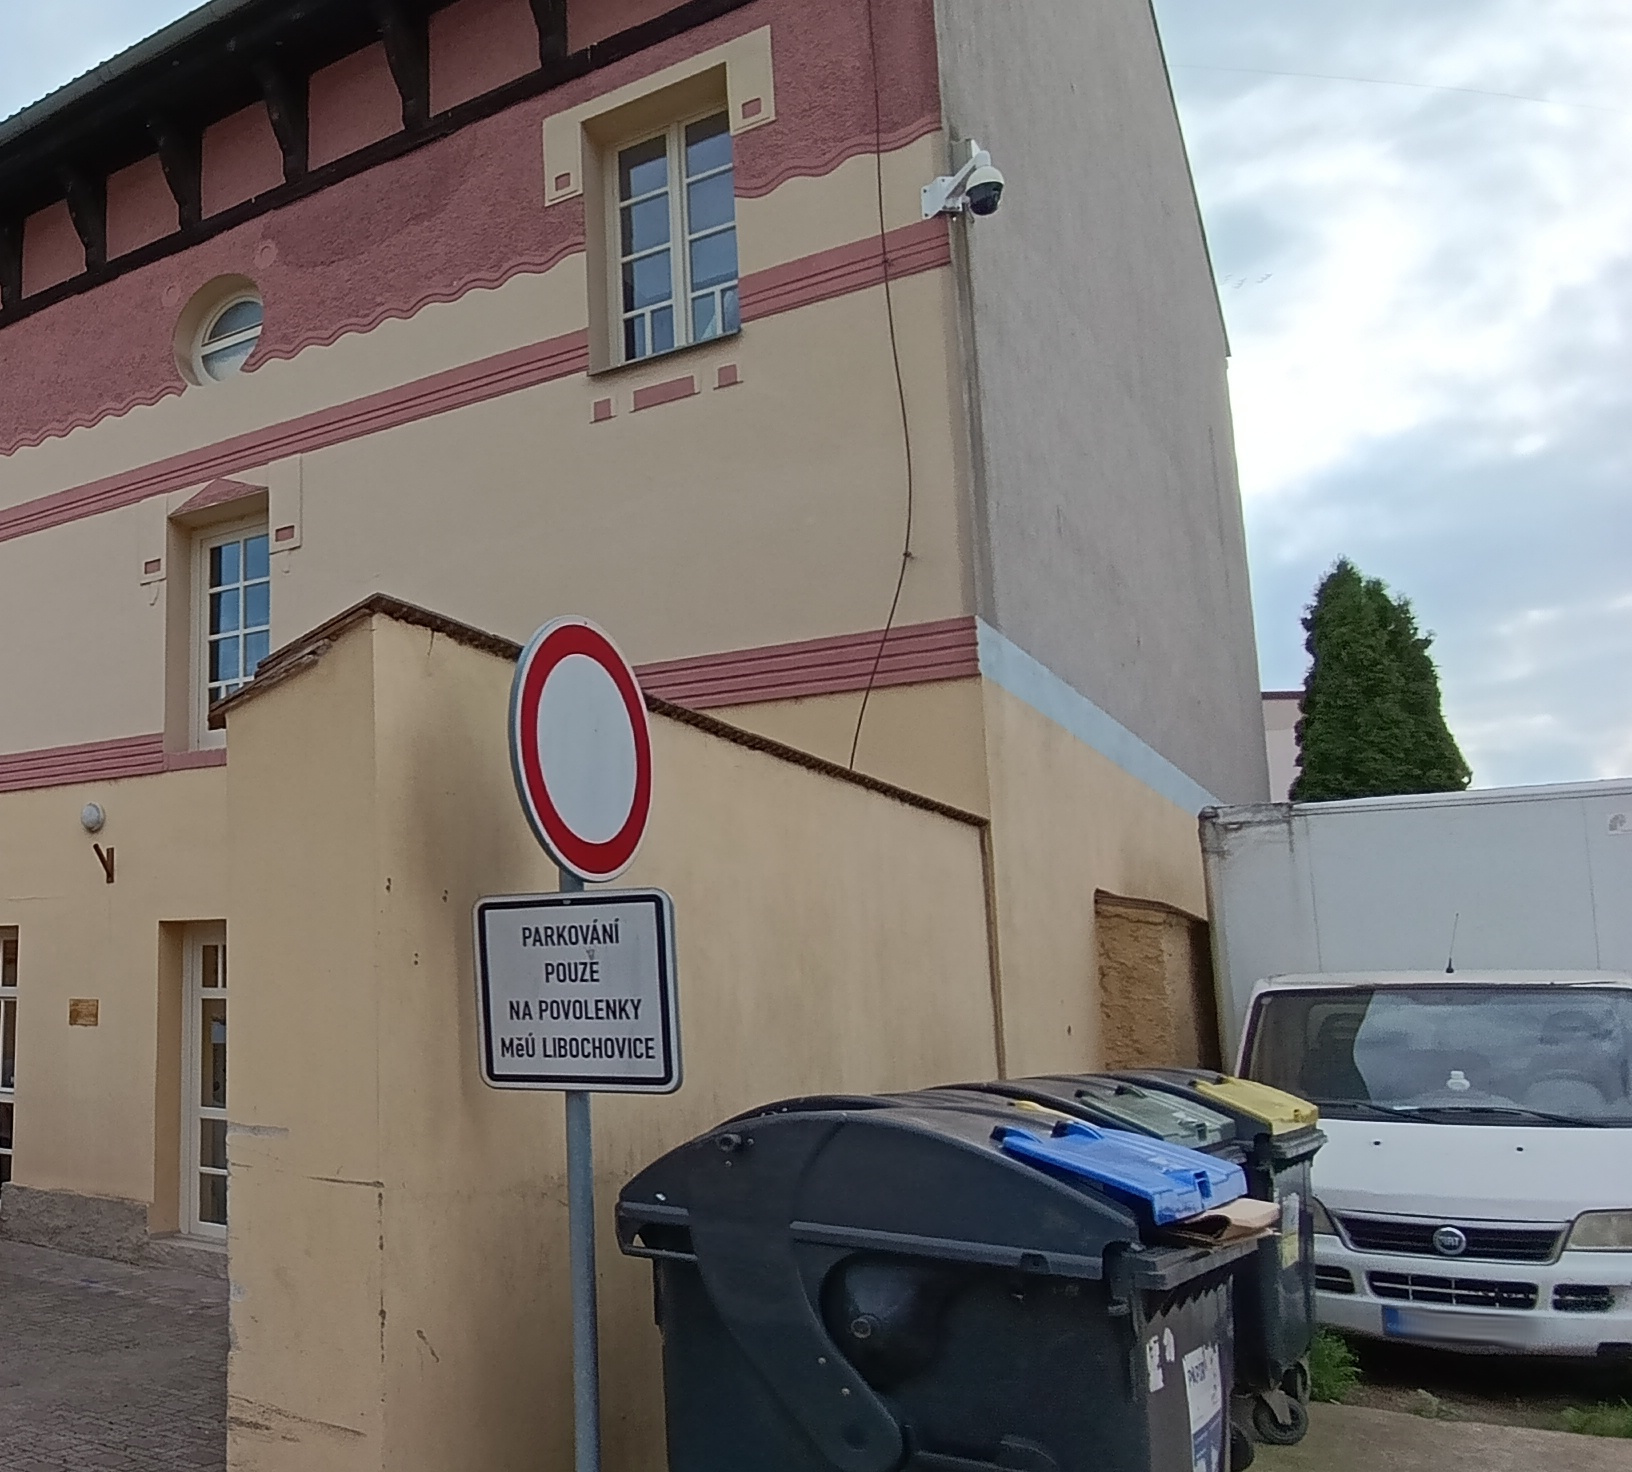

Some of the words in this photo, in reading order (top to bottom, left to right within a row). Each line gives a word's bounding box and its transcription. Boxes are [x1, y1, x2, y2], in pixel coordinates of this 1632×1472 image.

[521, 917, 620, 947] PARKOVÁNÍ
[544, 961, 600, 983] POUZE
[508, 1000, 534, 1021] NA
[538, 998, 642, 1021] POVOLENKY
[500, 1032, 536, 1059] MěÚ
[542, 1036, 656, 1060] LIBOCHOVICE
